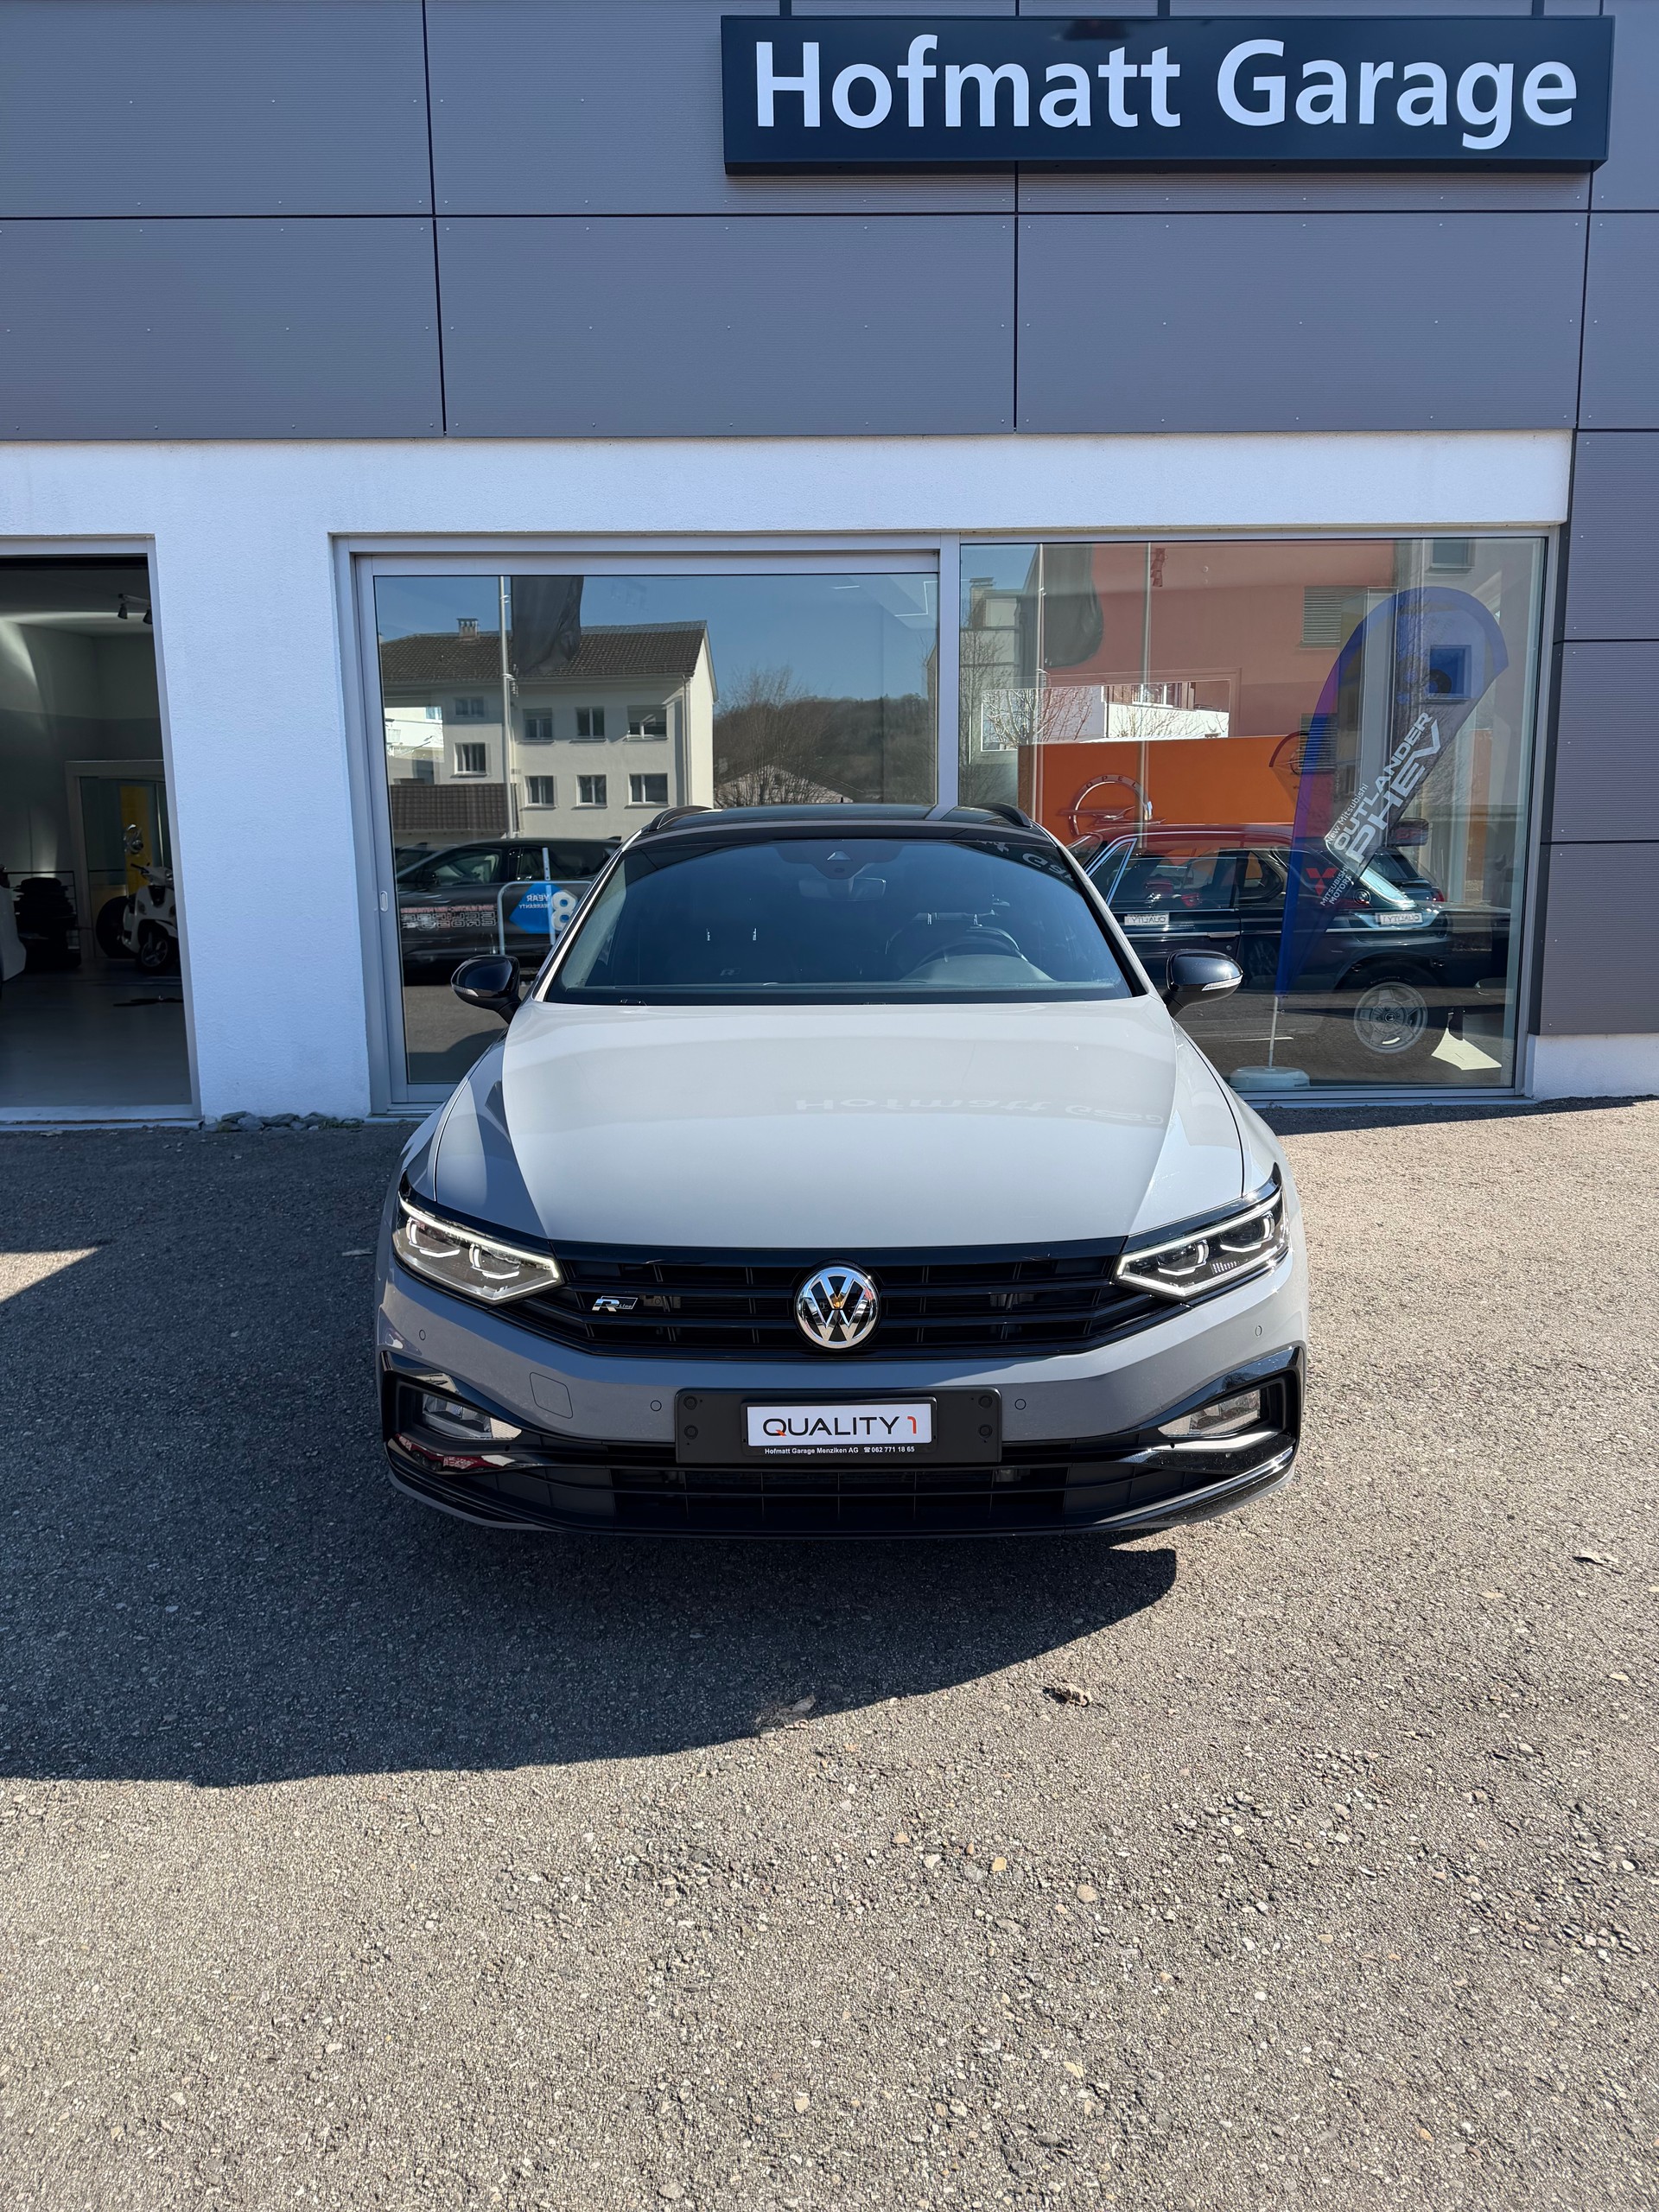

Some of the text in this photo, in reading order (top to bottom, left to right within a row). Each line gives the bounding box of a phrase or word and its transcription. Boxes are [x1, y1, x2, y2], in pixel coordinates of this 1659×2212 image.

[754, 35, 1577, 149] Hofmatt Garage
[1085, 775, 1141, 790] OPEL
[1333, 712, 1433, 851] OUTLANDER
[1345, 719, 1441, 864] PHEV
[1325, 784, 1369, 844] New Mitsubishi
[1320, 865, 1350, 906] MITSUBISHI
[1329, 874, 1352, 905] MOTORS
[762, 1415, 918, 1437] QUALITY 1
